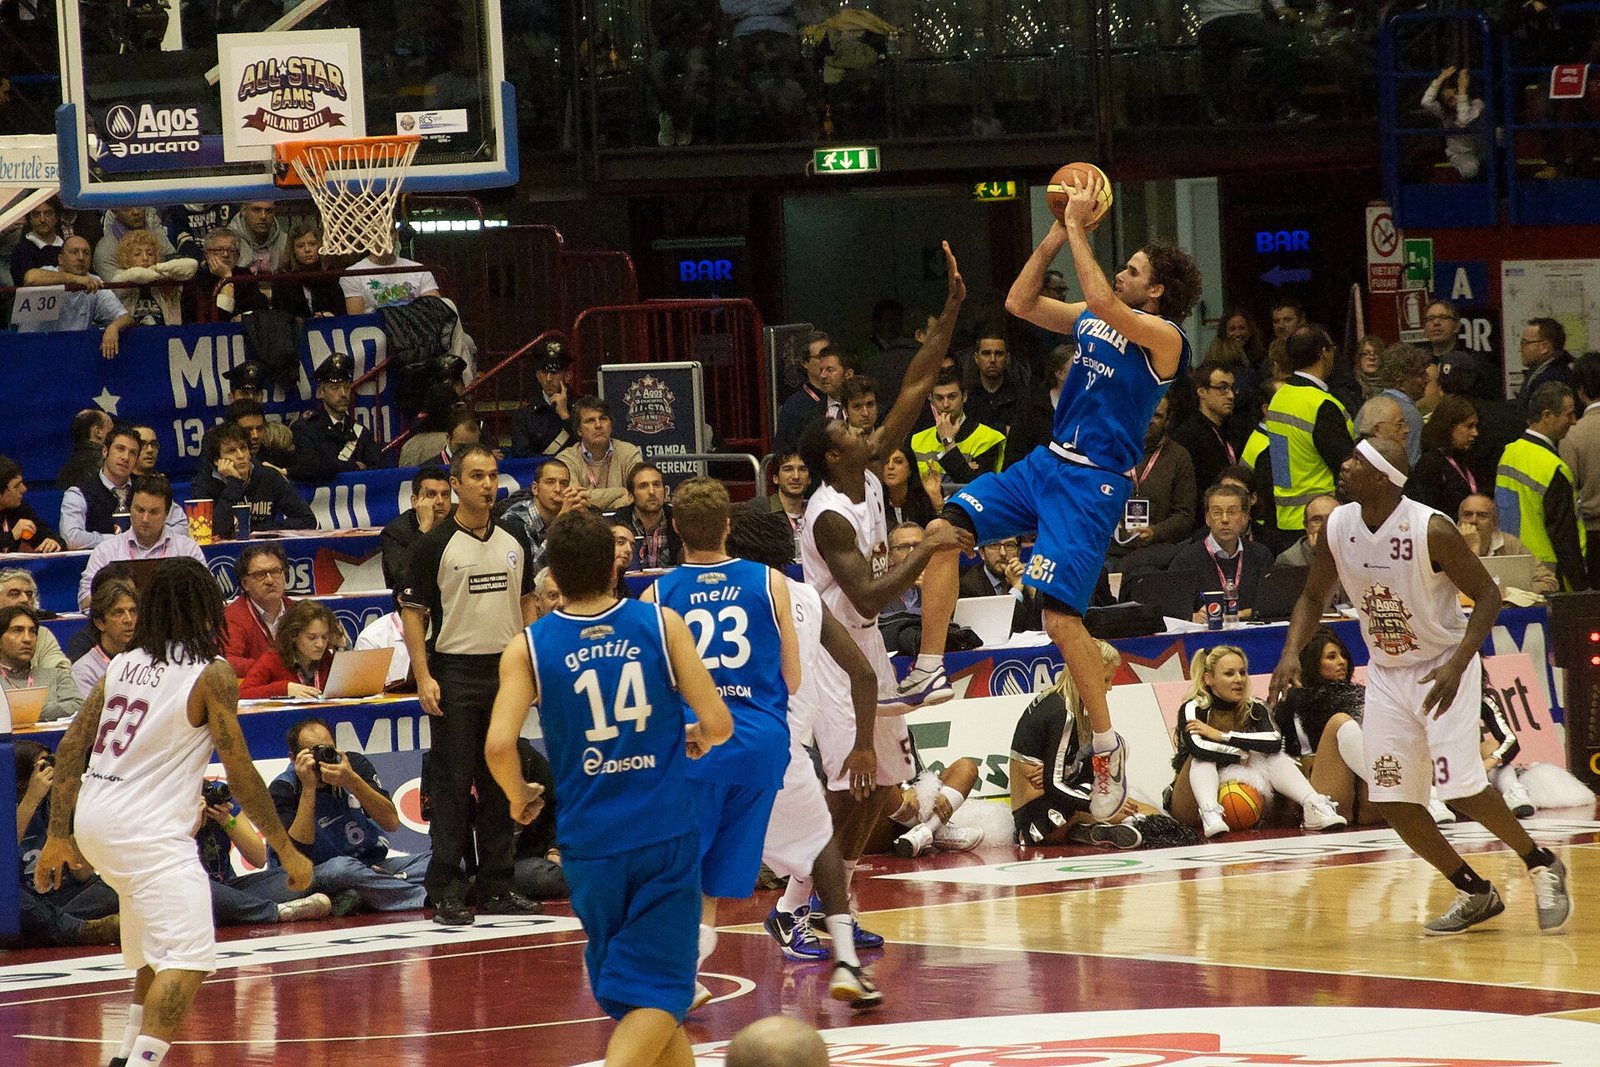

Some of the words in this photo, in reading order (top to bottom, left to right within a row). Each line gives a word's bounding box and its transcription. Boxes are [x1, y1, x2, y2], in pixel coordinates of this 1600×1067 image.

[239, 58, 281, 101] ALL
[287, 56, 347, 101] STAR
[271, 88, 315, 111] GAME
[137, 104, 199, 139] Agos
[262, 112, 300, 131] MILANO
[302, 112, 324, 130] 2011
[129, 140, 200, 155] DUCATO
[1256, 230, 1310, 253] BAR
[679, 259, 733, 282] BAR
[1451, 267, 1473, 300] A
[18, 298, 31, 312] A
[37, 296, 56, 311] 30
[1457, 317, 1492, 352] AR
[173, 418, 204, 457] 13
[646, 444, 686, 457] STAMPA
[1389, 537, 1413, 561] 33
[690, 586, 742, 605] melli
[684, 605, 751, 670] 23
[564, 639, 641, 672] gentile
[119, 661, 165, 688] MOSS
[573, 661, 653, 742] 14
[93, 693, 149, 759] 23
[602, 754, 656, 773] EDISON
[345, 821, 365, 846] 6
